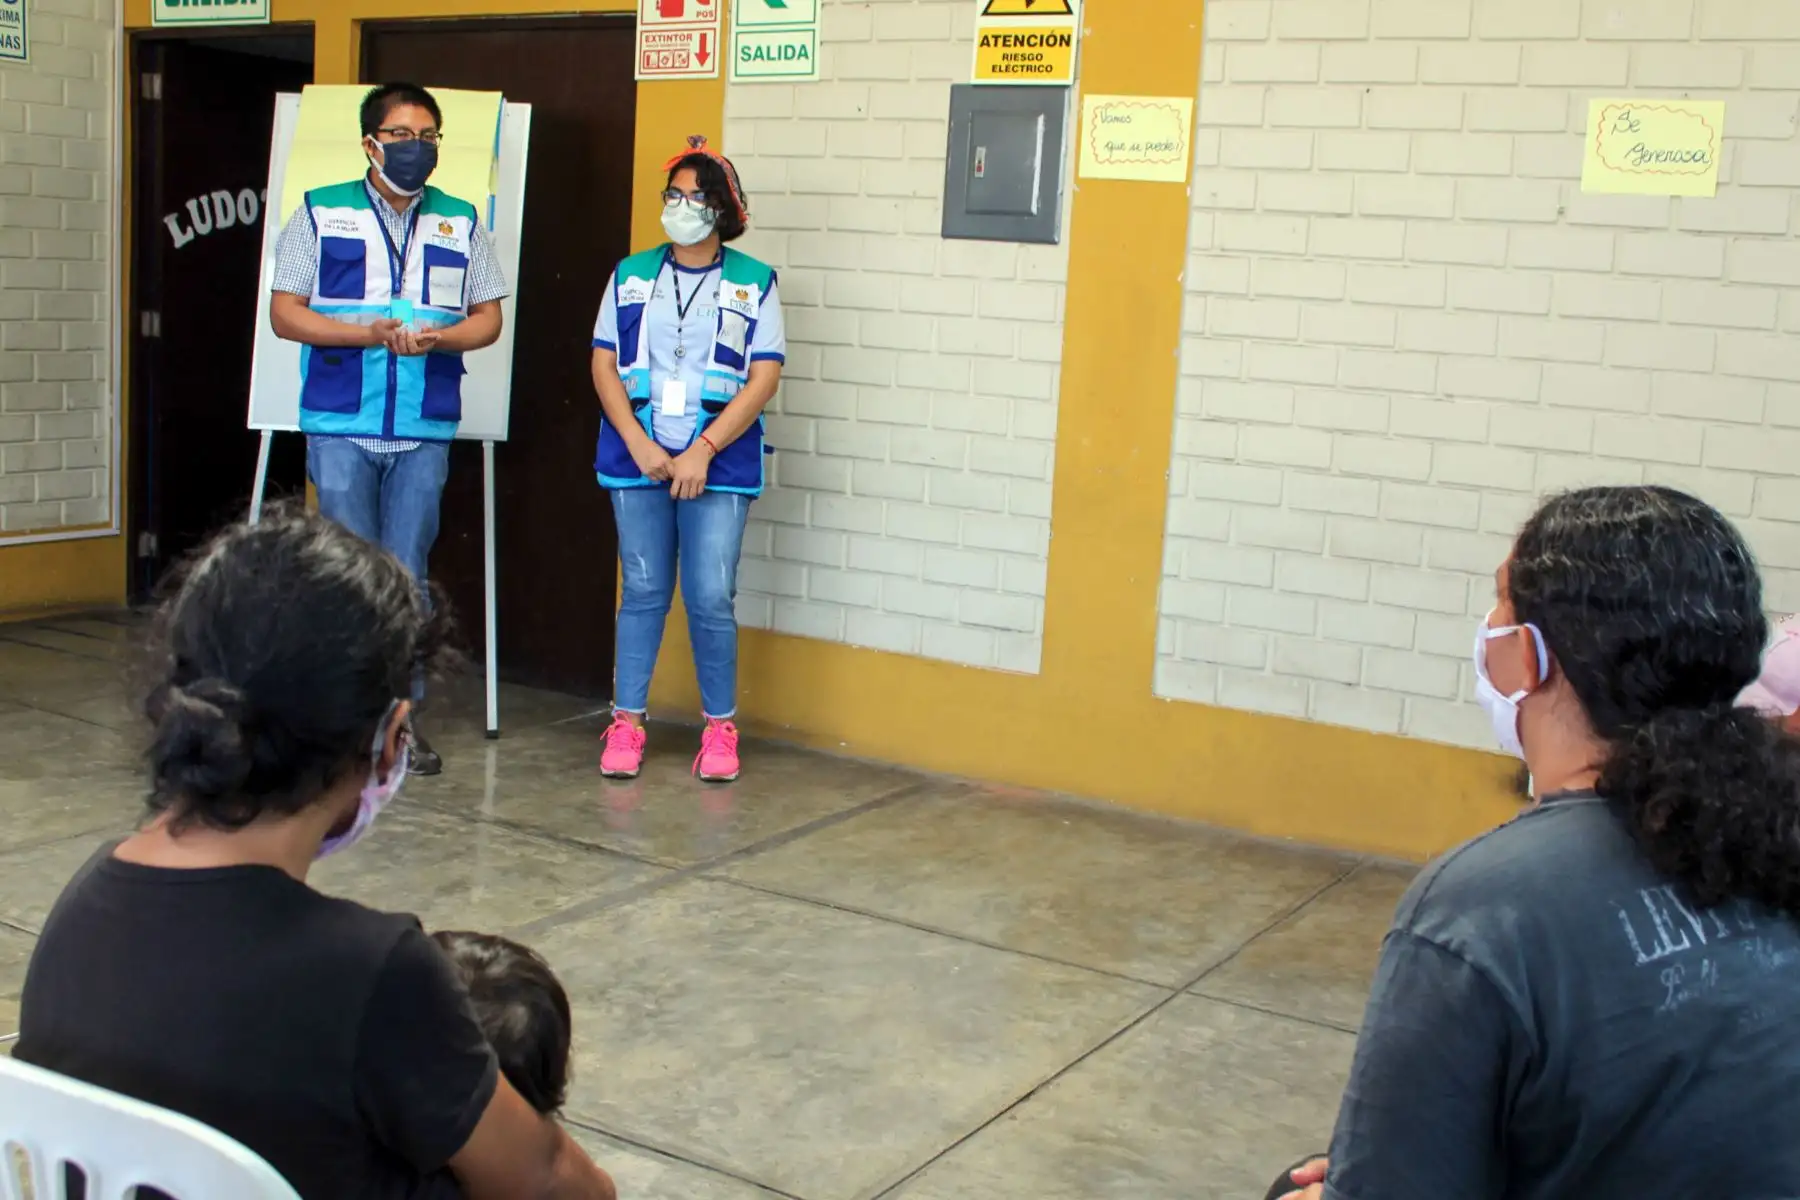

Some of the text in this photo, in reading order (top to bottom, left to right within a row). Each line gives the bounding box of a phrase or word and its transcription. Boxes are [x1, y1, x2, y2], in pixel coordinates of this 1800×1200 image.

[645, 32, 692, 43] EXTINTOR
[979, 29, 1072, 48] ATENCIÓN
[740, 44, 809, 62] SALIDA
[1002, 52, 1044, 62] RIESGO
[1100, 107, 1132, 124] Vamos
[1611, 109, 1641, 135] Se
[1103, 140, 1127, 158] que
[1624, 142, 1710, 167] Generosa
[163, 188, 267, 250] LUDO
